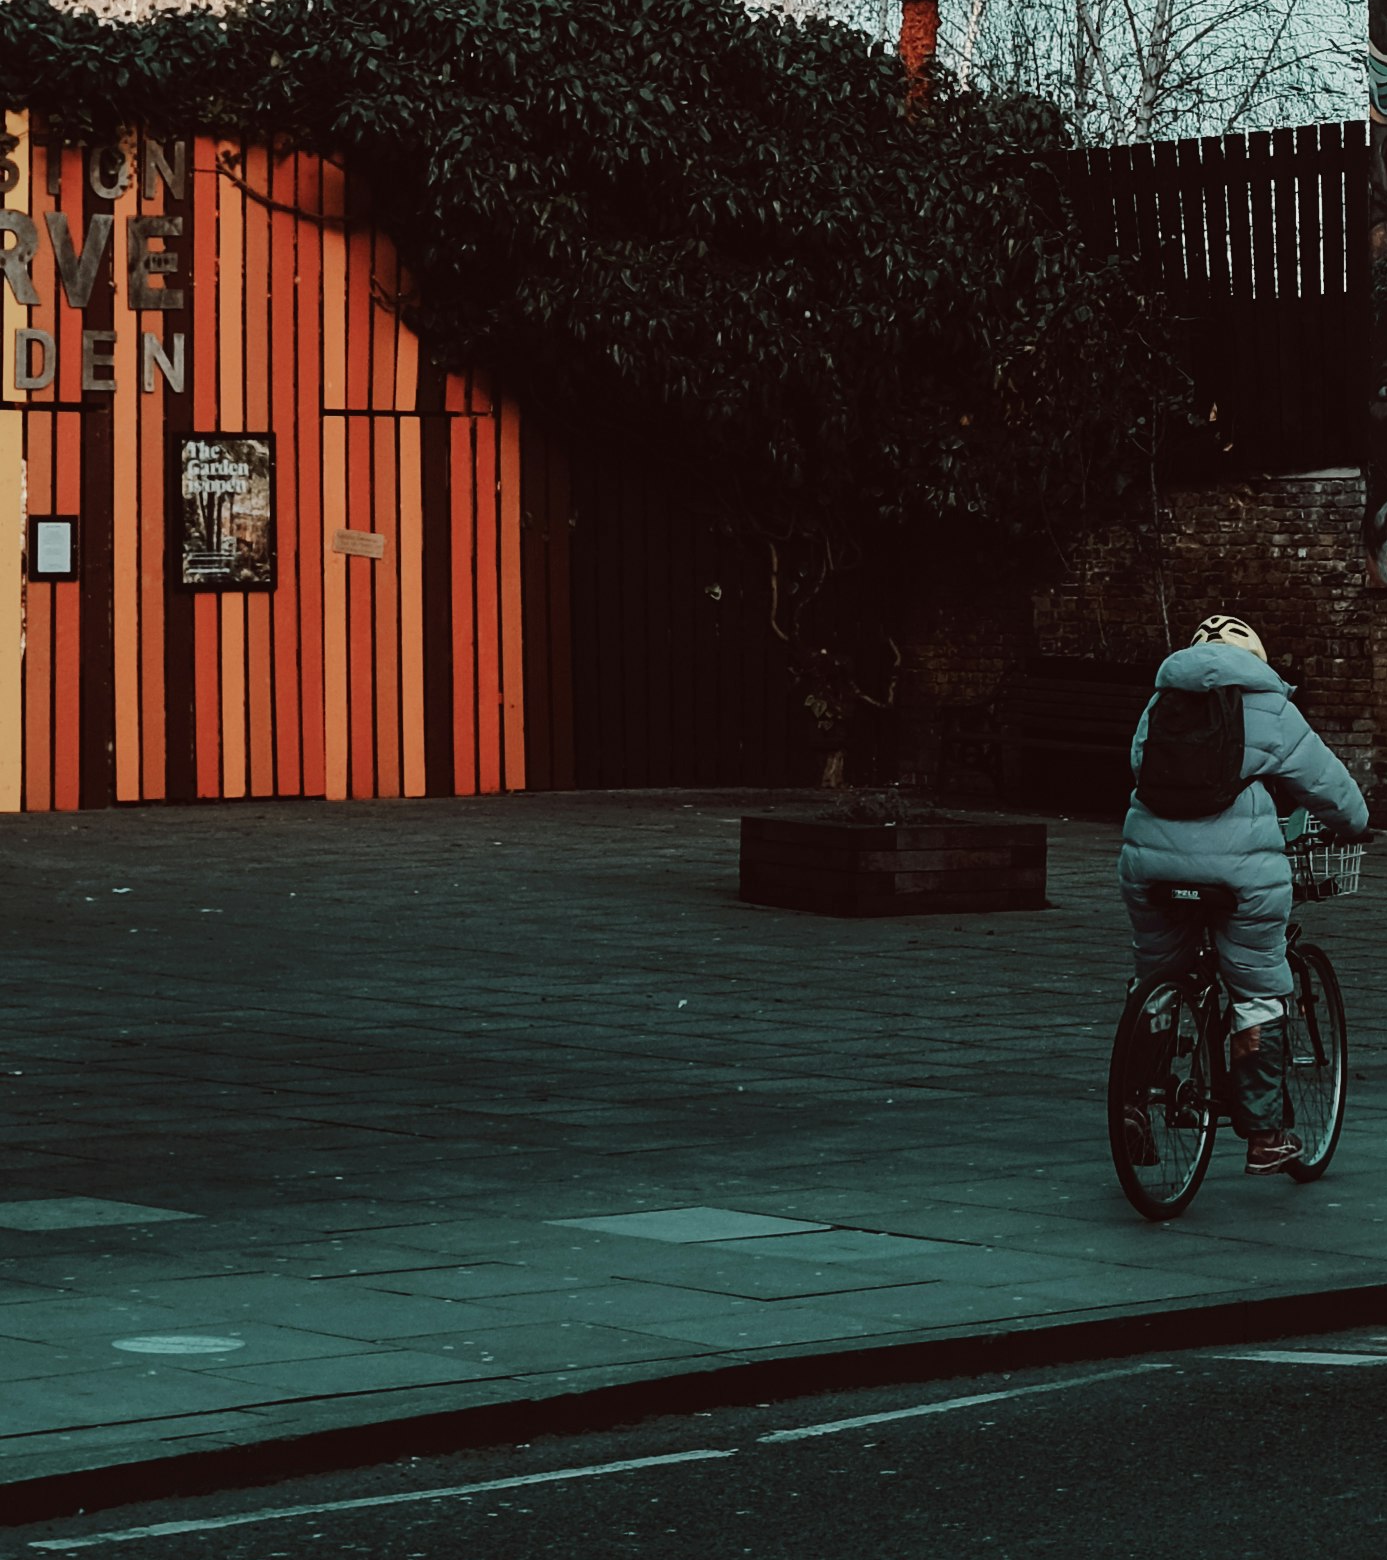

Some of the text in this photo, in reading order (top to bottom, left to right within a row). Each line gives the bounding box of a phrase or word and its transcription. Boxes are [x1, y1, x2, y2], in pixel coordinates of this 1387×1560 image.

[0, 209, 185, 311] RVE
[15, 328, 185, 394] DEN
[187, 441, 221, 460] The
[187, 460, 249, 477] Garden
[201, 480, 249, 496] open
